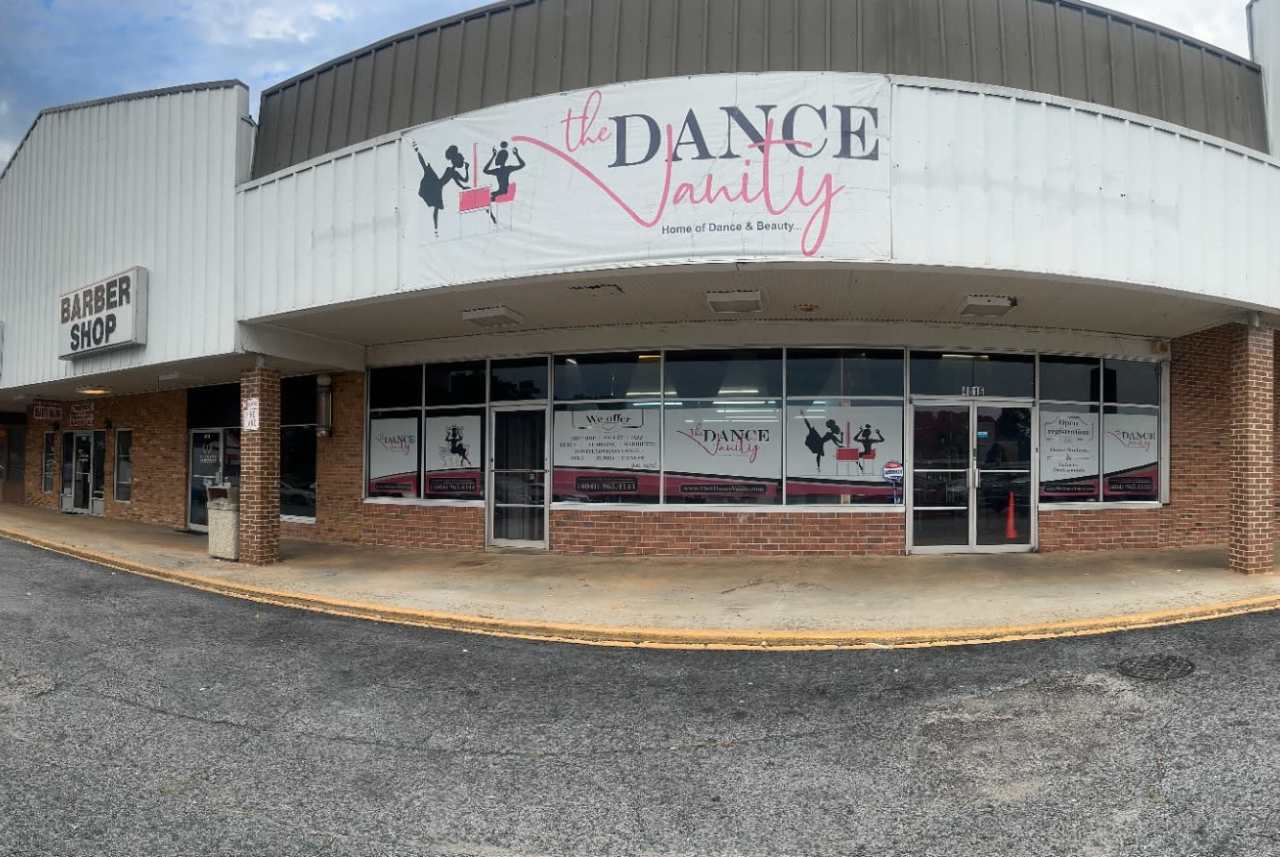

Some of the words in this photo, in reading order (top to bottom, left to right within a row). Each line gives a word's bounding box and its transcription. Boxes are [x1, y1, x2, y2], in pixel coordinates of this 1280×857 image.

[561, 90, 612, 152] the
[608, 103, 879, 168] DANCE
[510, 118, 846, 256] Vanity
[661, 225, 692, 235] Home
[695, 223, 706, 233] of
[708, 222, 743, 232] Dance
[745, 222, 753, 231] &
[61, 275, 130, 324] BARBER
[70, 313, 117, 351] SHOP
[585, 415, 604, 425] We
[606, 413, 632, 424] offer
[703, 429, 770, 442] DANCE
